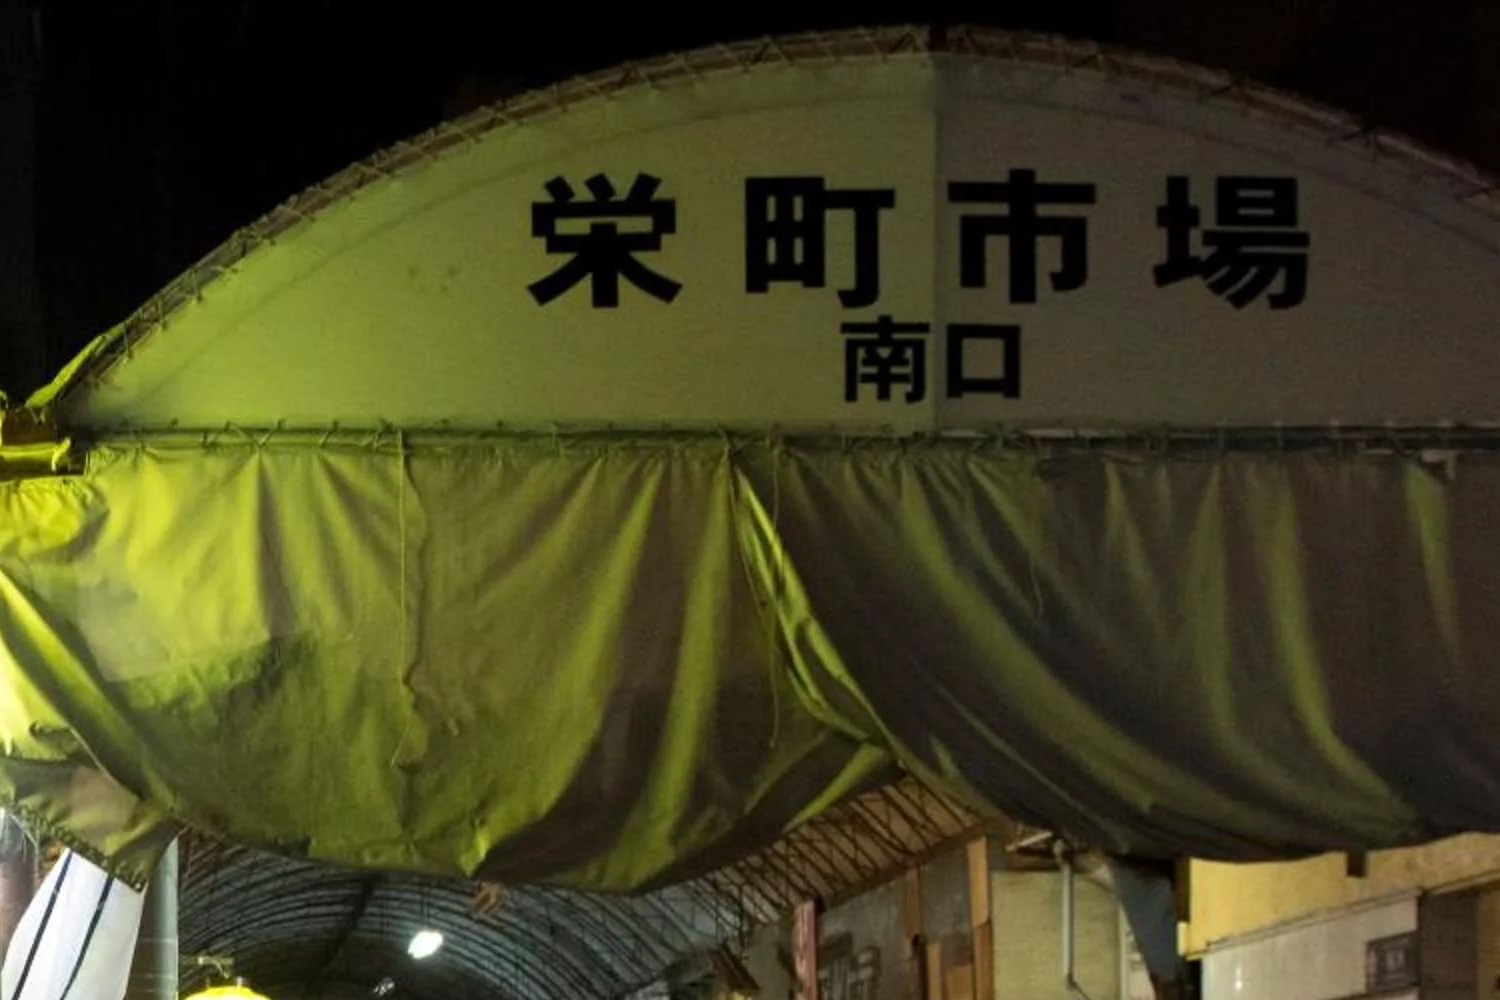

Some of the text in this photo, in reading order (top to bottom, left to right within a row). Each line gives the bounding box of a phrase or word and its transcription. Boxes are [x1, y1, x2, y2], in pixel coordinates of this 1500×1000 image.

[527, 169, 1309, 309] 栄町市場
[841, 315, 1021, 402] 南口
